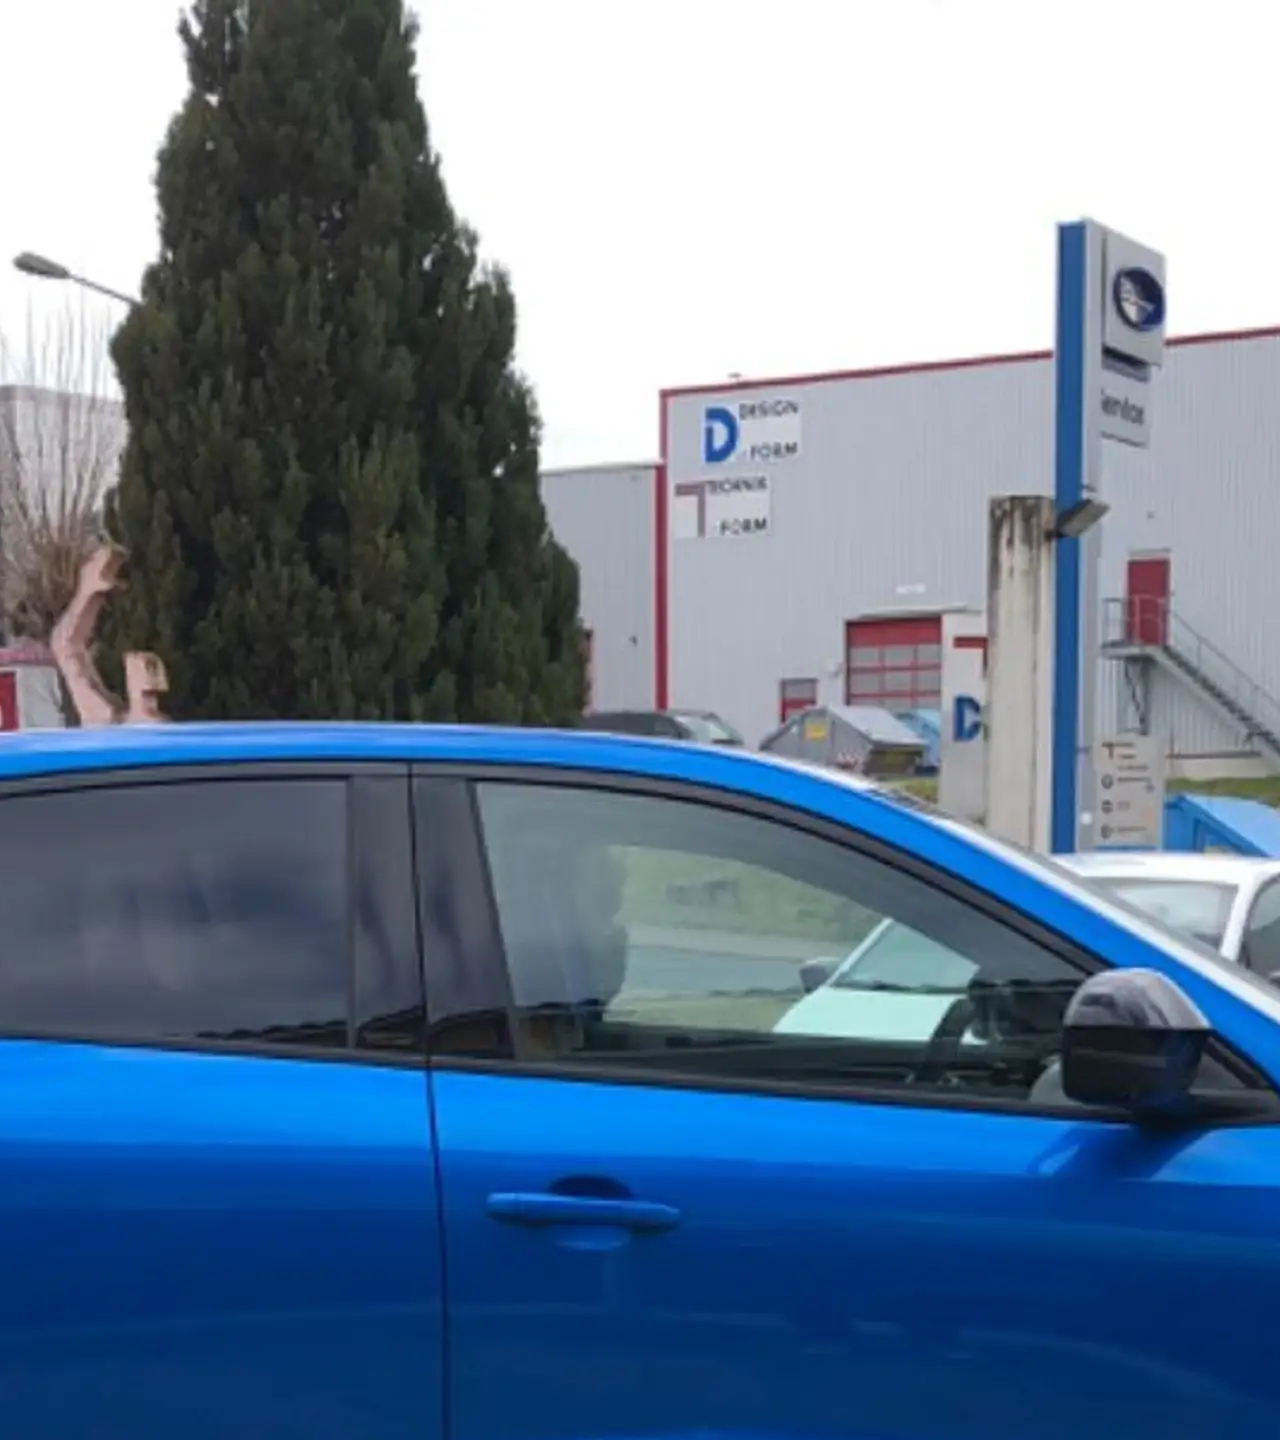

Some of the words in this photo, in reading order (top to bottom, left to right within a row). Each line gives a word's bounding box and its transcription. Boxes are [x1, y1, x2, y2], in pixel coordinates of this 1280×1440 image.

[738, 400, 799, 421] DESIGN
[750, 442, 798, 460] FORM
[720, 517, 767, 536] FORM
